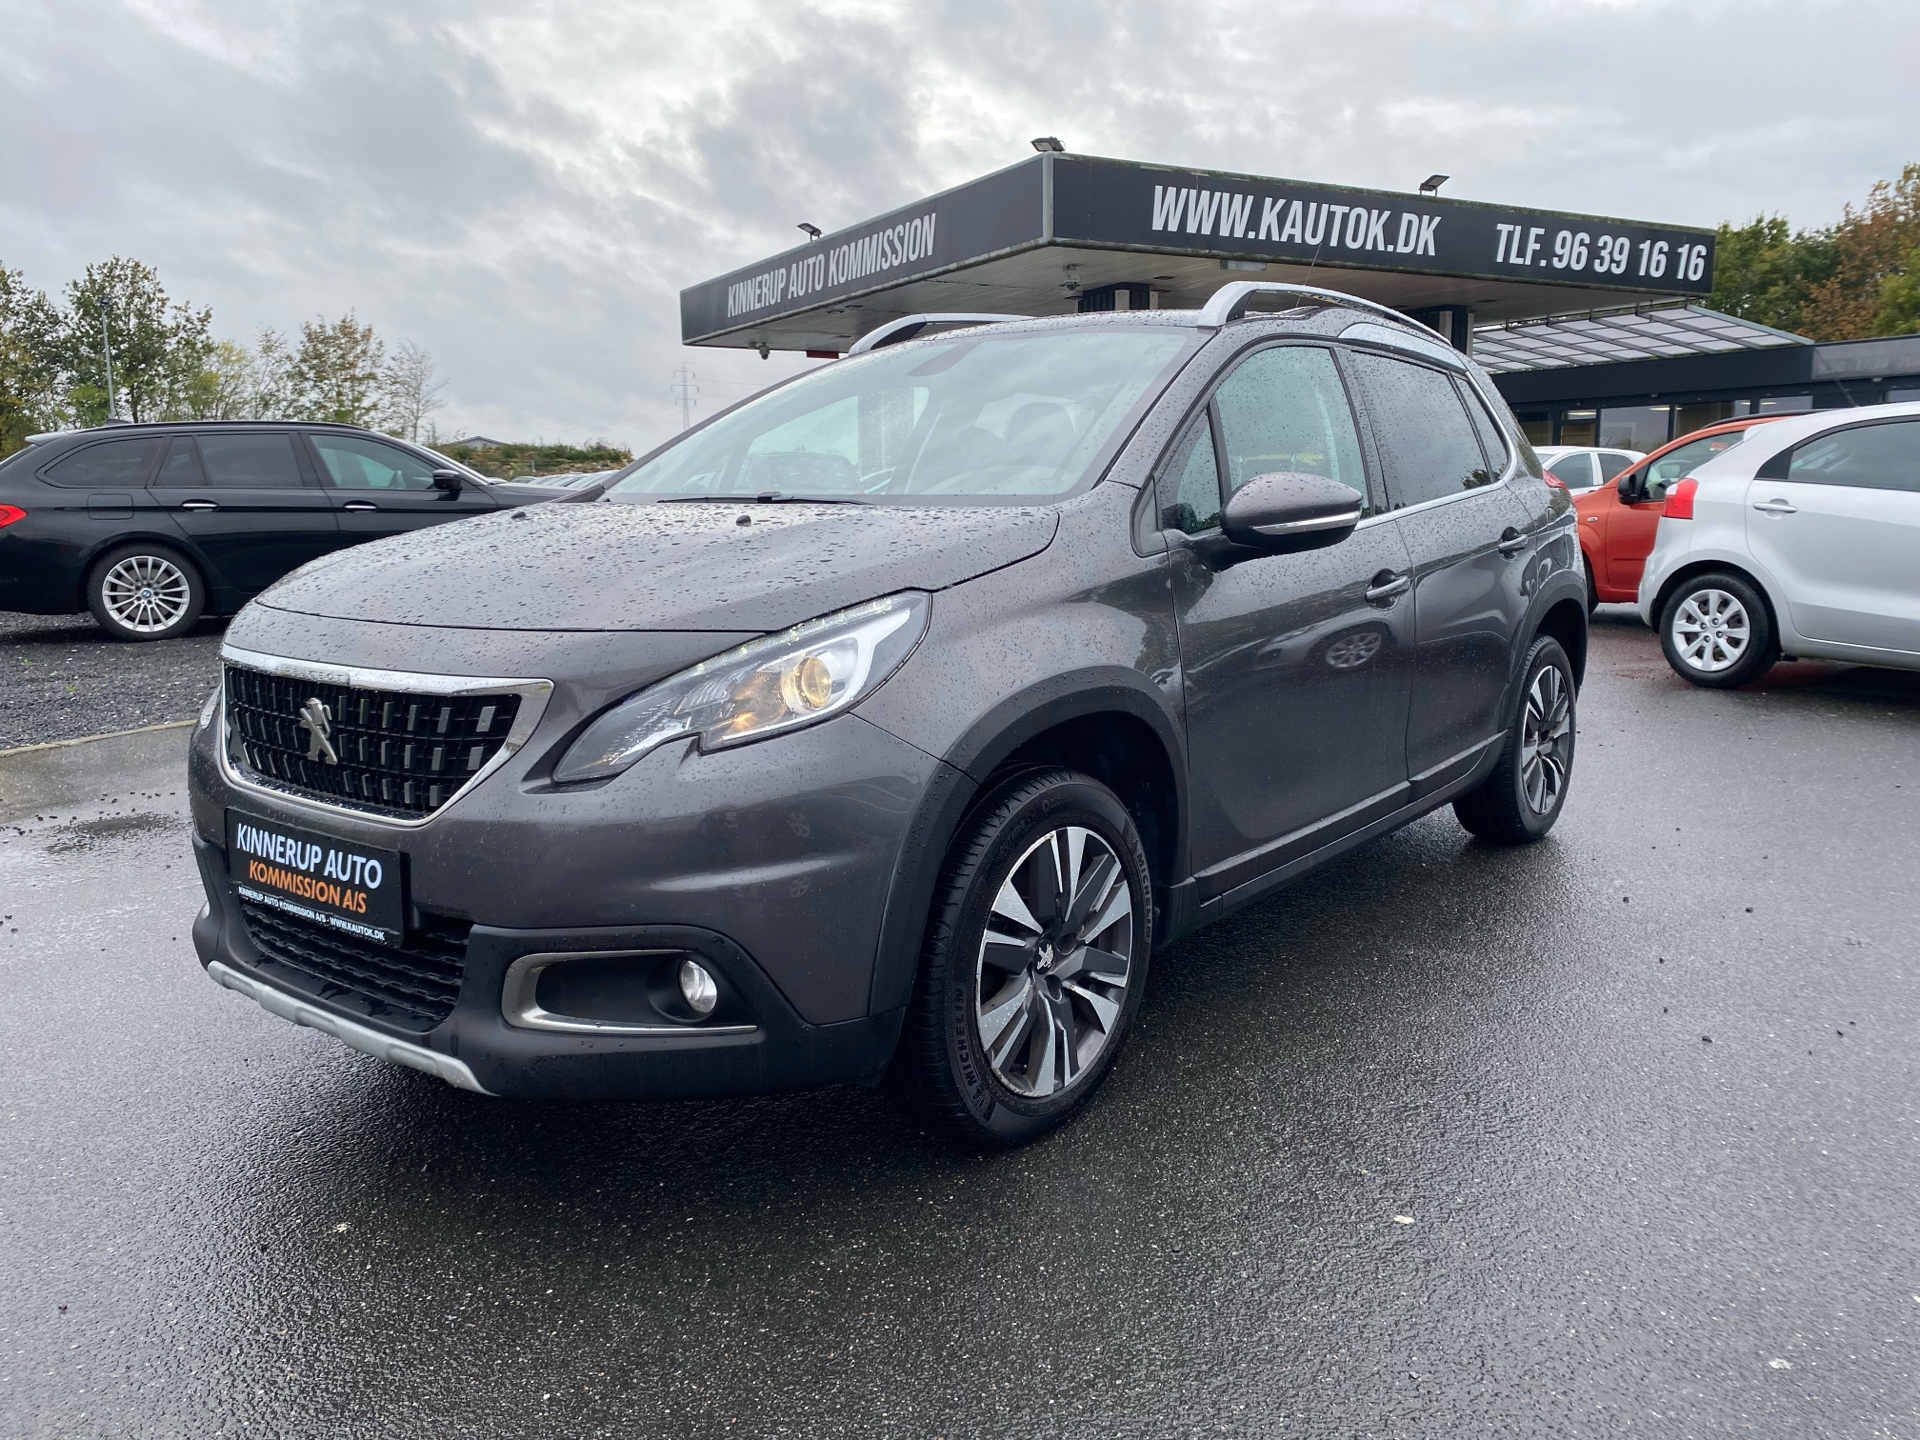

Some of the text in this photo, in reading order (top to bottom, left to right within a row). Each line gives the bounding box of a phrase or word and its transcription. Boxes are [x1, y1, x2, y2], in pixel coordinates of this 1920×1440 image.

[727, 212, 937, 318] KINNERUP AUTO KOMMISSION
[1151, 185, 1708, 282] WWW.KAUTOK.DK TLF. 96 39 16 16
[237, 822, 383, 890] KINNERUP AUTO
[249, 859, 342, 907] KOMMISSION
[238, 886, 264, 902] KINNERUP
[264, 894, 279, 907] AUTO
[279, 900, 315, 919] KOMMISSION
[315, 912, 327, 923] A/S
[329, 917, 385, 940] WWW.KAUTOK.DK
[954, 987, 978, 1088] MICHELIN
